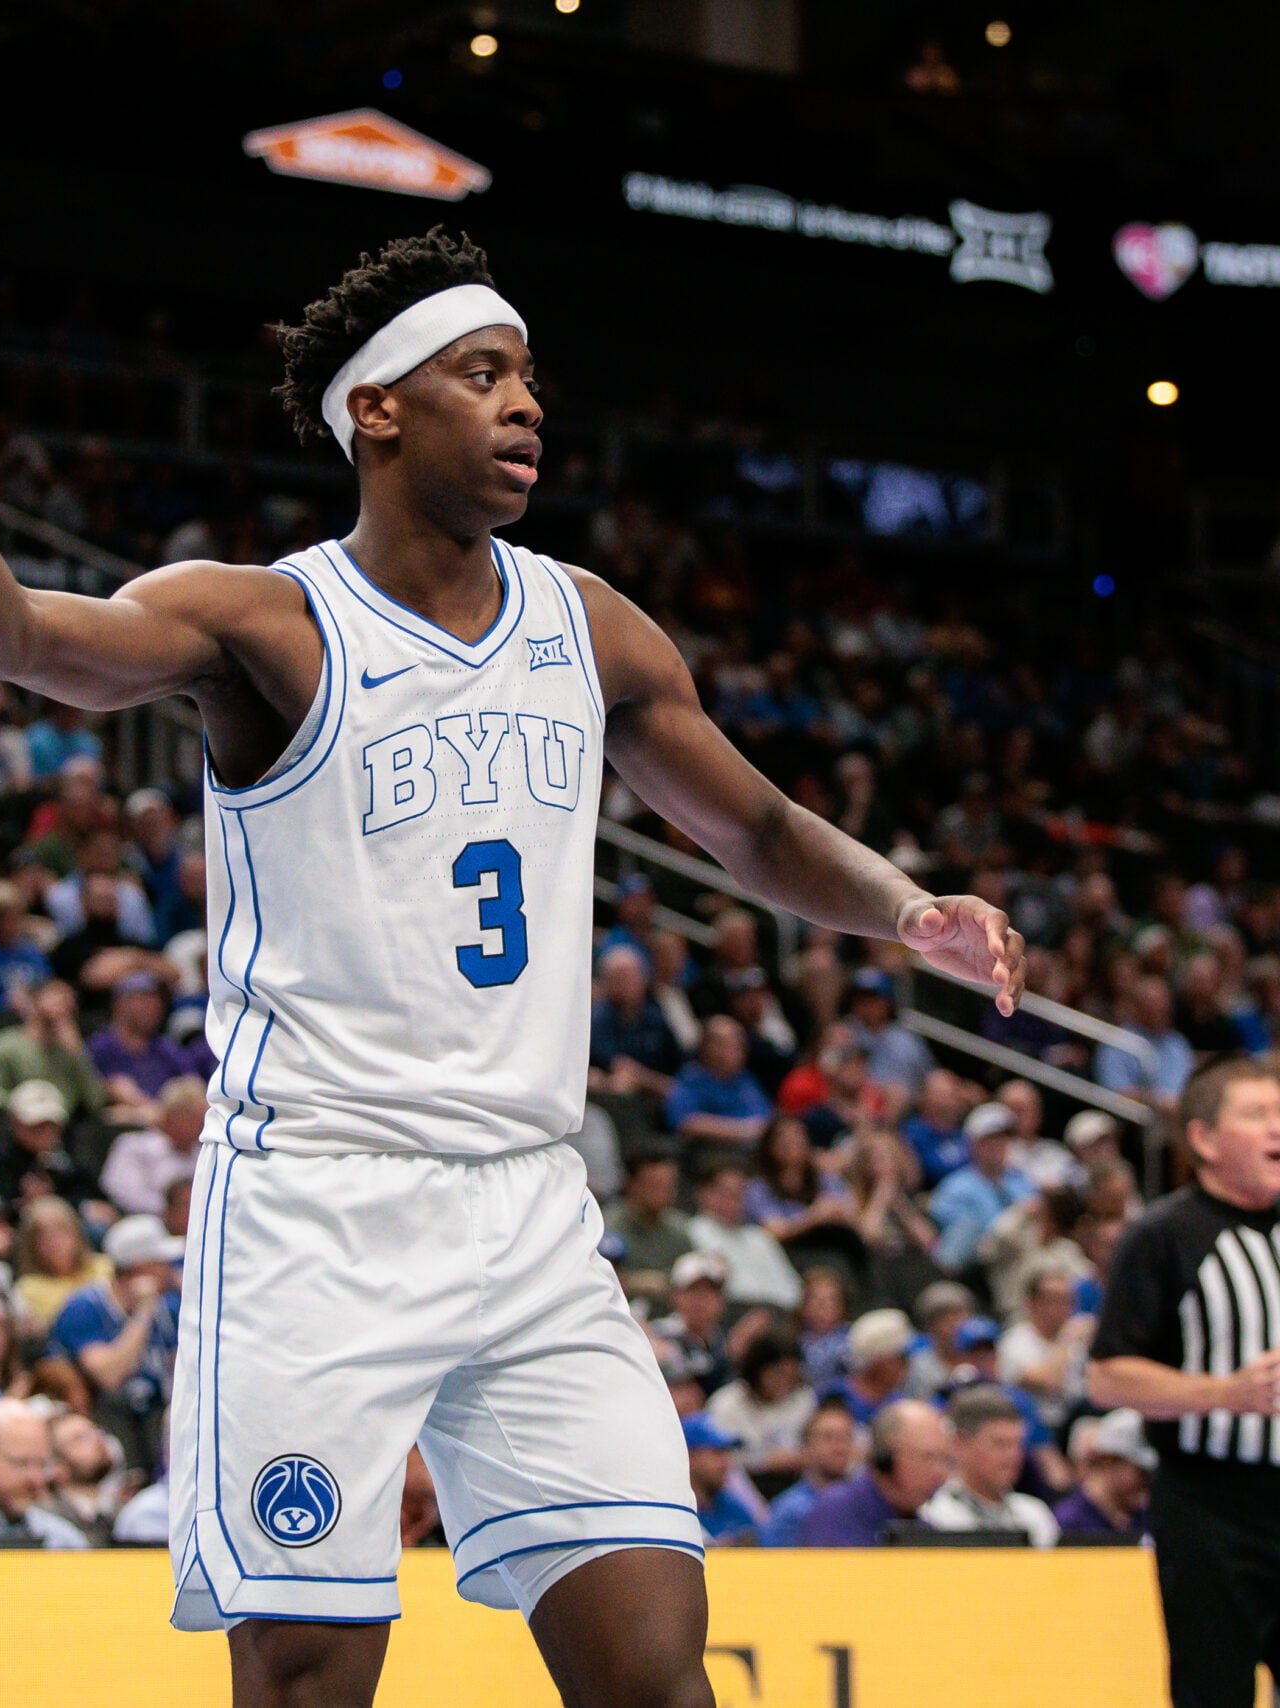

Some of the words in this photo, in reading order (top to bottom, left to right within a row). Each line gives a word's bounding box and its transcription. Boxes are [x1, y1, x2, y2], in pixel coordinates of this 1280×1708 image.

[363, 711, 585, 836] BYU
[452, 838, 529, 989] 3
[280, 1509, 309, 1532] Y
